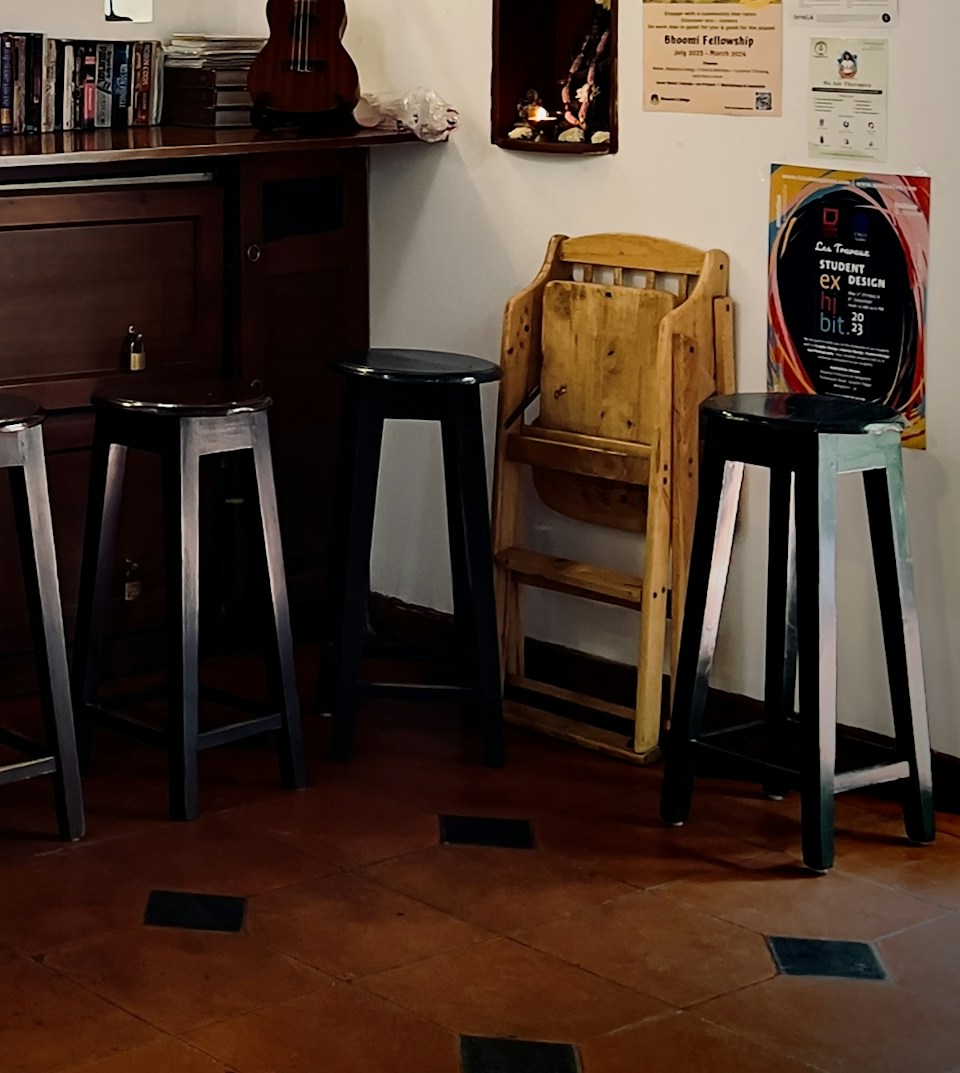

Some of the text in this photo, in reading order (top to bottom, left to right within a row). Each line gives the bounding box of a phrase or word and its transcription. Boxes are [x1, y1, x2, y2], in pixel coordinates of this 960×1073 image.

[664, 35, 754, 48] Bhoomi Fellowship
[142, 43, 151, 86] ROBIN COOK
[814, 241, 832, 253] Les
[819, 259, 865, 274] STUDENT
[820, 273, 886, 290] ex DESIGN
[820, 311, 850, 335] bit.
[851, 311, 865, 322] 20
[851, 322, 864, 336] 23
